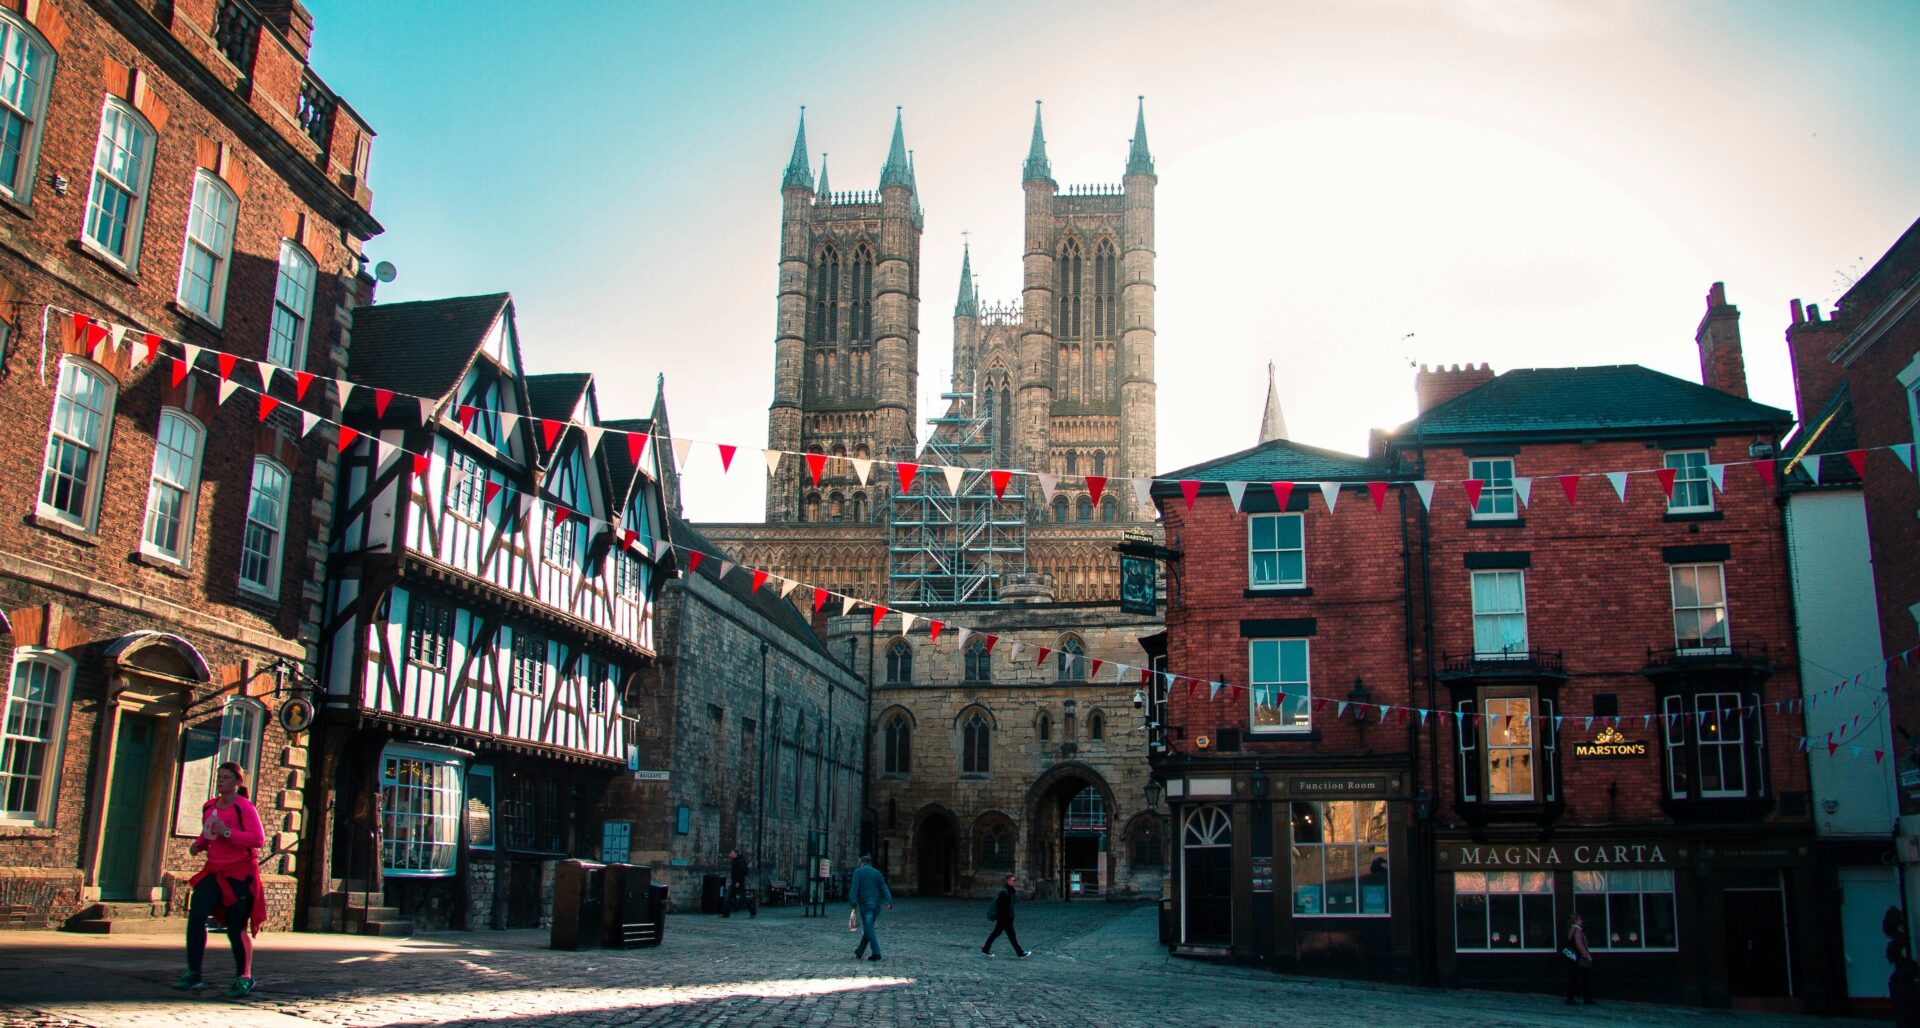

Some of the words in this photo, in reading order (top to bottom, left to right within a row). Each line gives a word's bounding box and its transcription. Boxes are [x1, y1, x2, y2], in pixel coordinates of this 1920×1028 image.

[1125, 533, 1152, 543] MARSTON'S
[1576, 744, 1645, 755] MARSTON'S
[1300, 781, 1344, 790] Function
[1348, 781, 1375, 789] Room
[1460, 847, 1562, 864] MAGNA
[1574, 845, 1666, 864] CARTA
